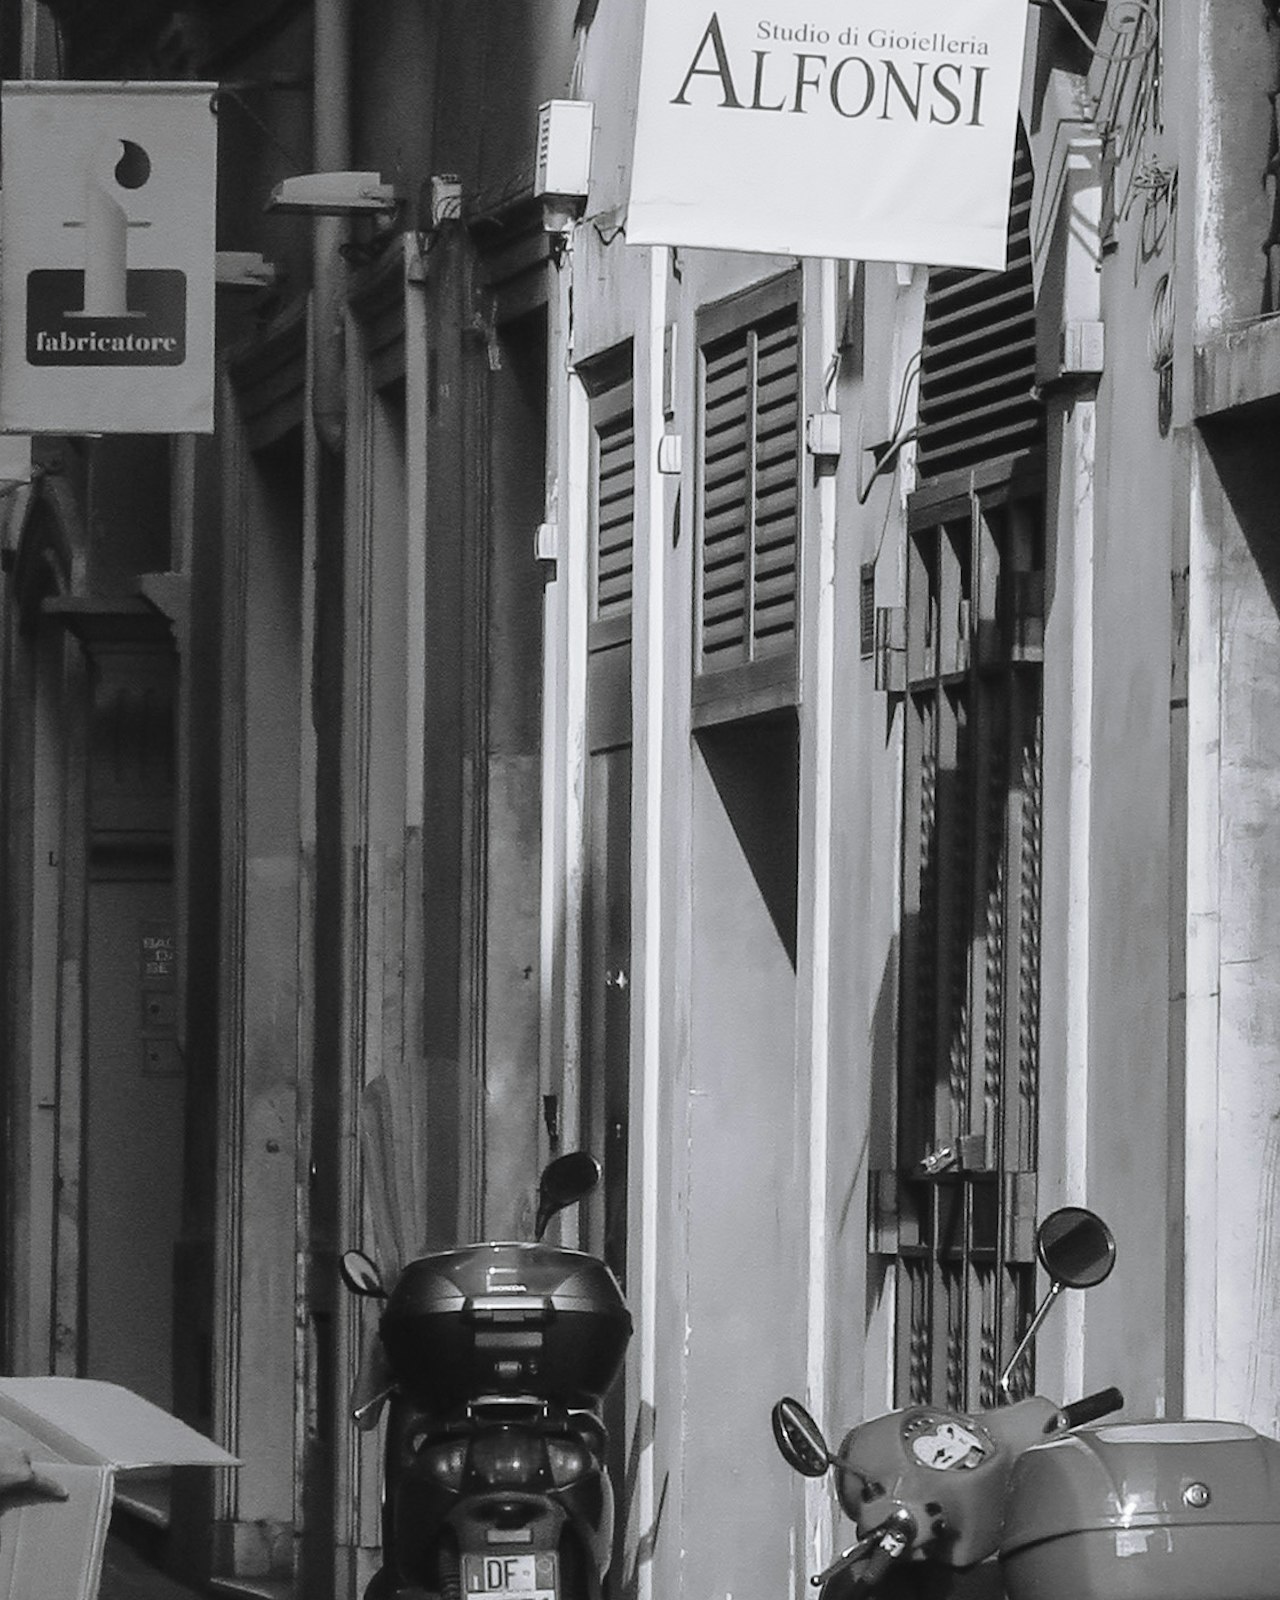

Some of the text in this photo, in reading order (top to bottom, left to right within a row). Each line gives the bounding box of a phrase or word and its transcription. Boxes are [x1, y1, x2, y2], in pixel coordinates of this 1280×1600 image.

[756, 20, 990, 56] Studio di Gioielleria
[669, 11, 990, 127] ALFONSI
[36, 331, 177, 351] fabricatore
[487, 1559, 519, 1589] DF
